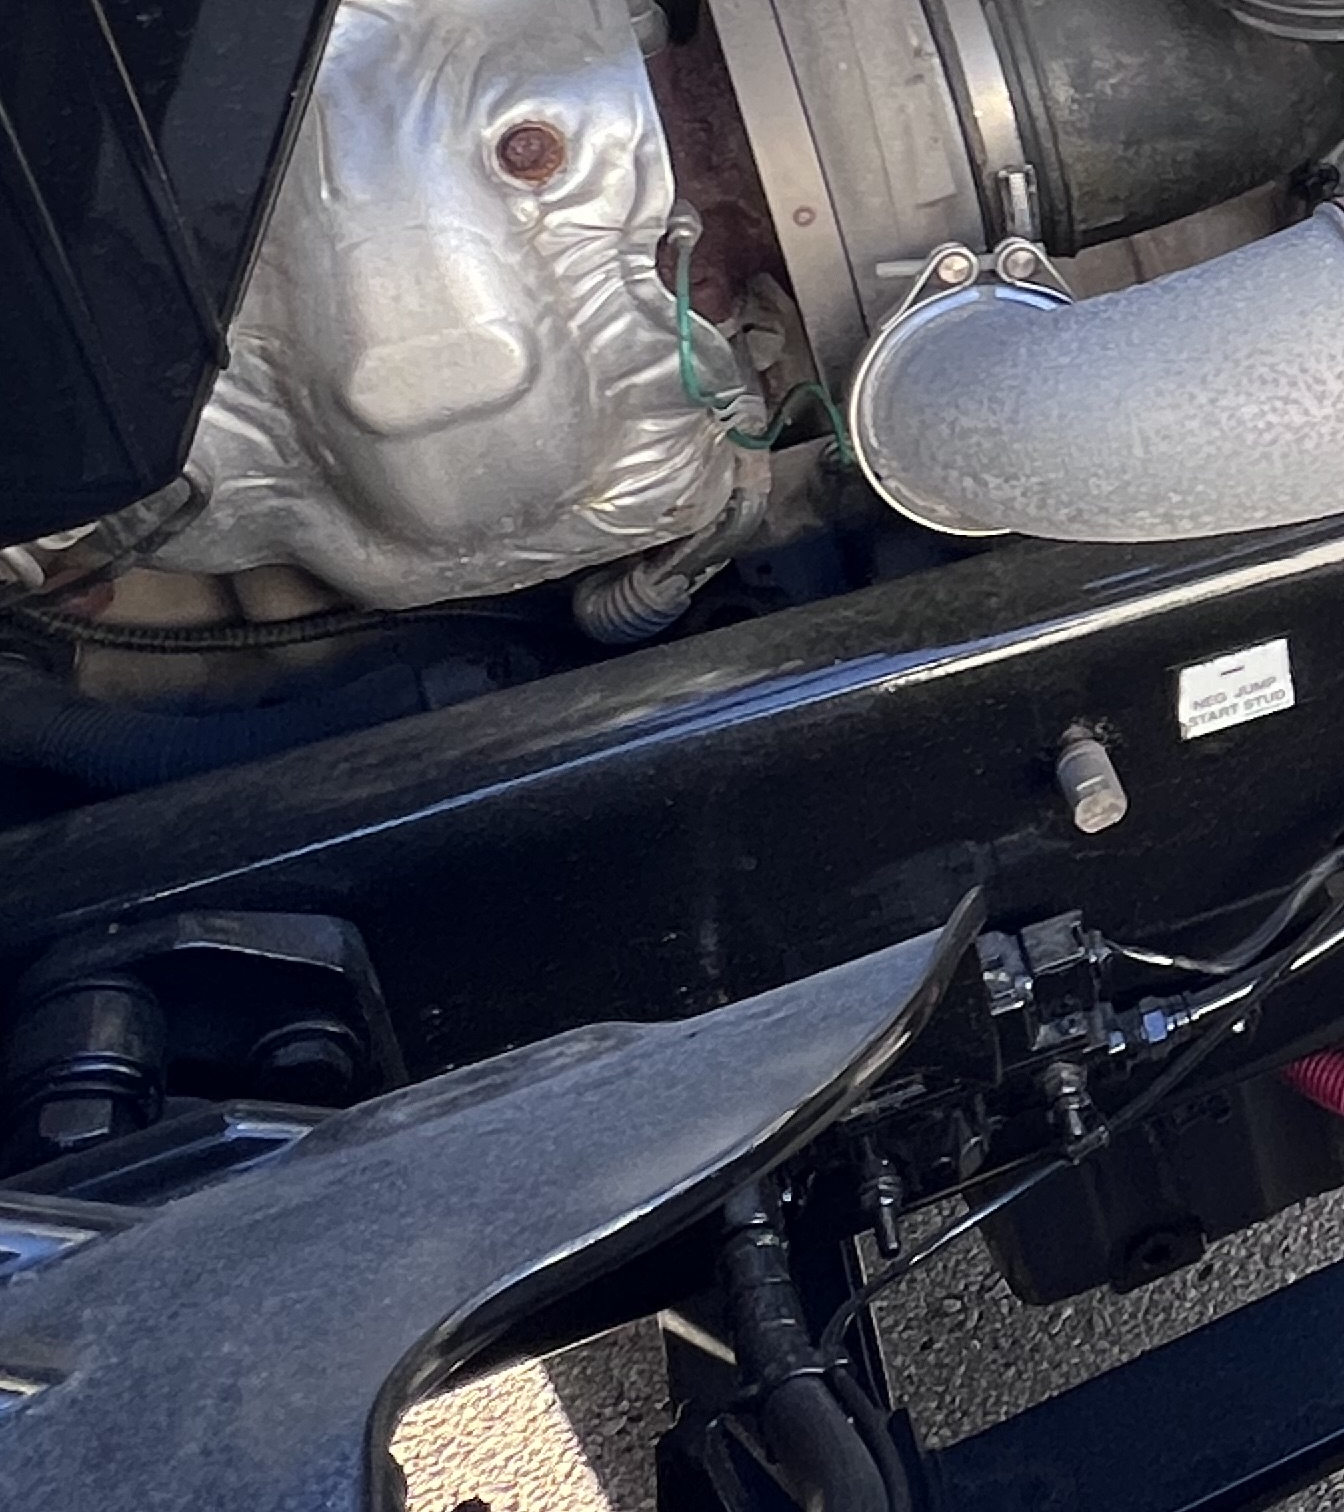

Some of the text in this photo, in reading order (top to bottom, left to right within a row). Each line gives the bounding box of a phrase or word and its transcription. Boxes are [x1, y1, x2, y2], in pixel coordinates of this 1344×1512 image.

[1233, 676, 1277, 698] JUMP
[1188, 702, 1239, 727] START
[1243, 688, 1286, 709] STUD
